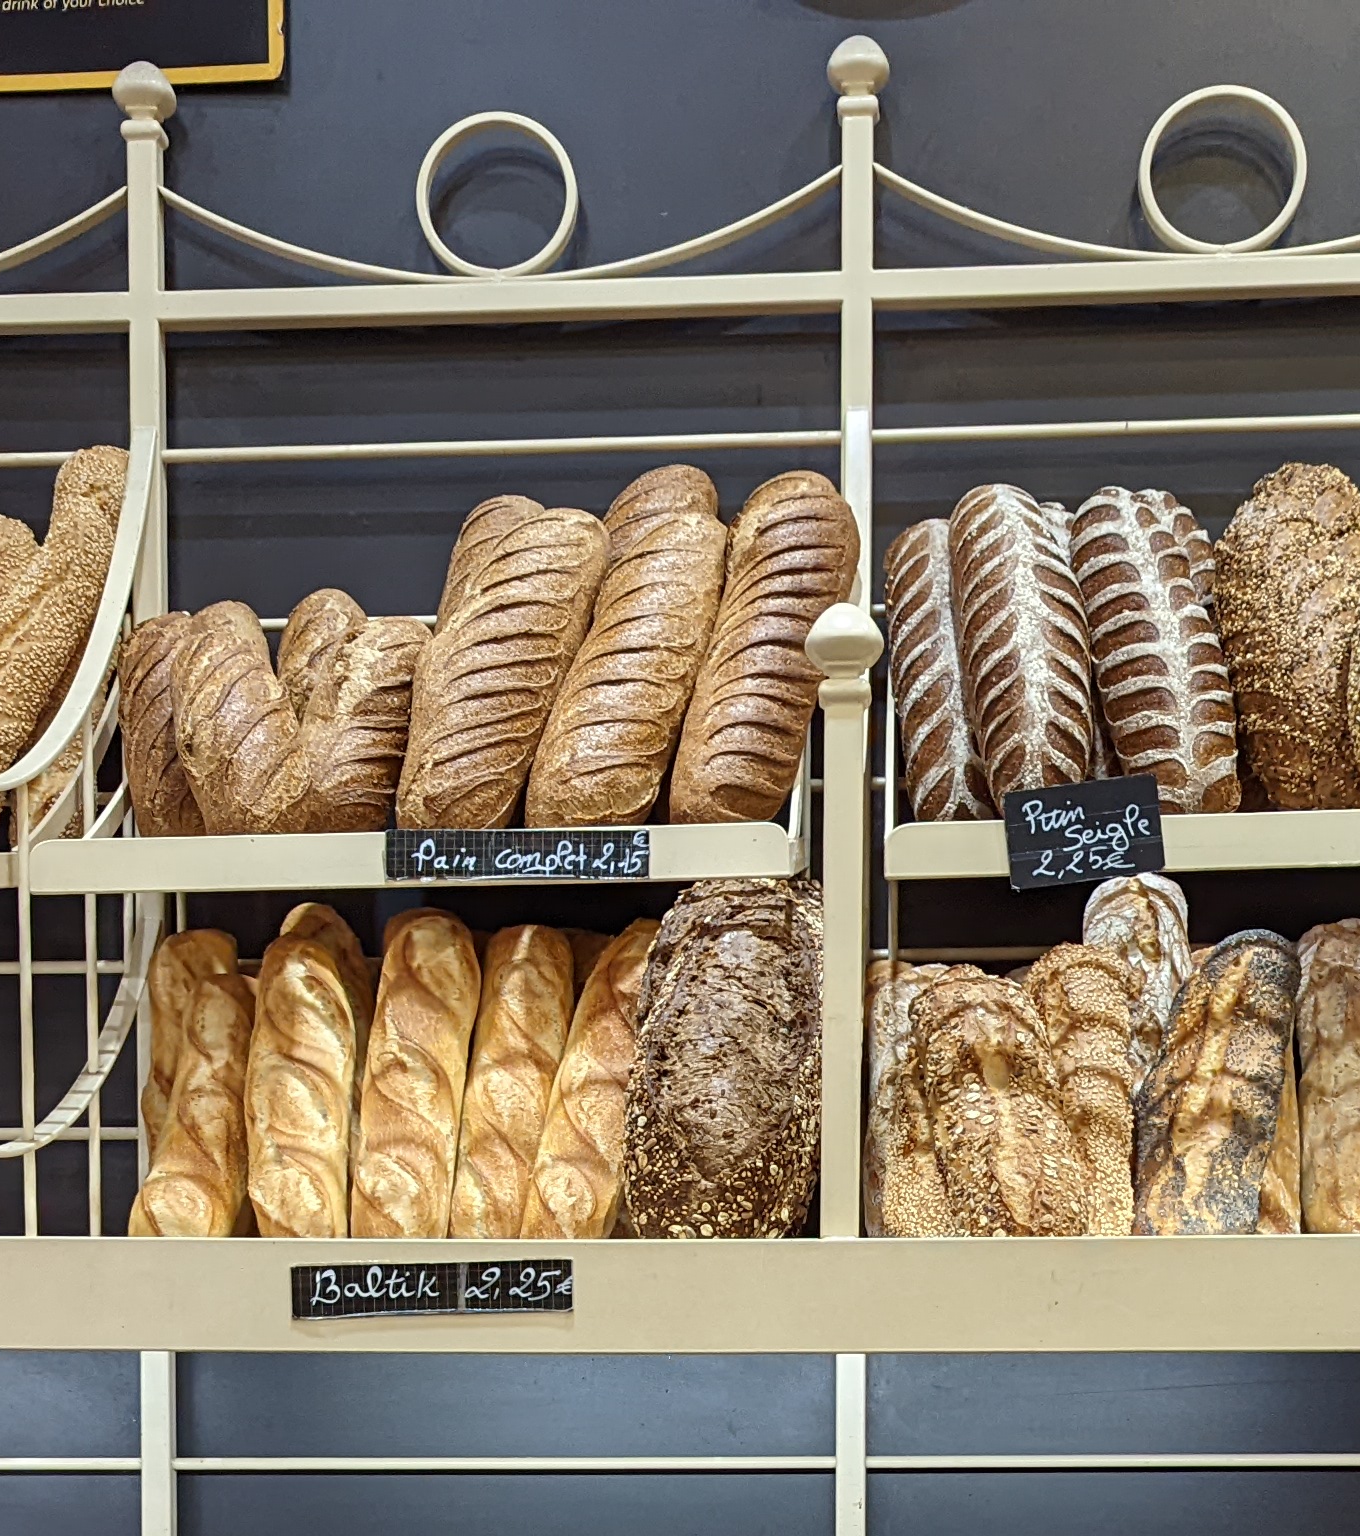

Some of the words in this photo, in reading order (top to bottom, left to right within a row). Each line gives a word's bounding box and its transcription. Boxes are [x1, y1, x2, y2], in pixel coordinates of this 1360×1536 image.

[2, 0, 40, 11] drink
[62, 0, 91, 11] your
[1022, 799, 1085, 834] Pain
[411, 838, 477, 871] Pain
[310, 1265, 441, 1306] Baltik
